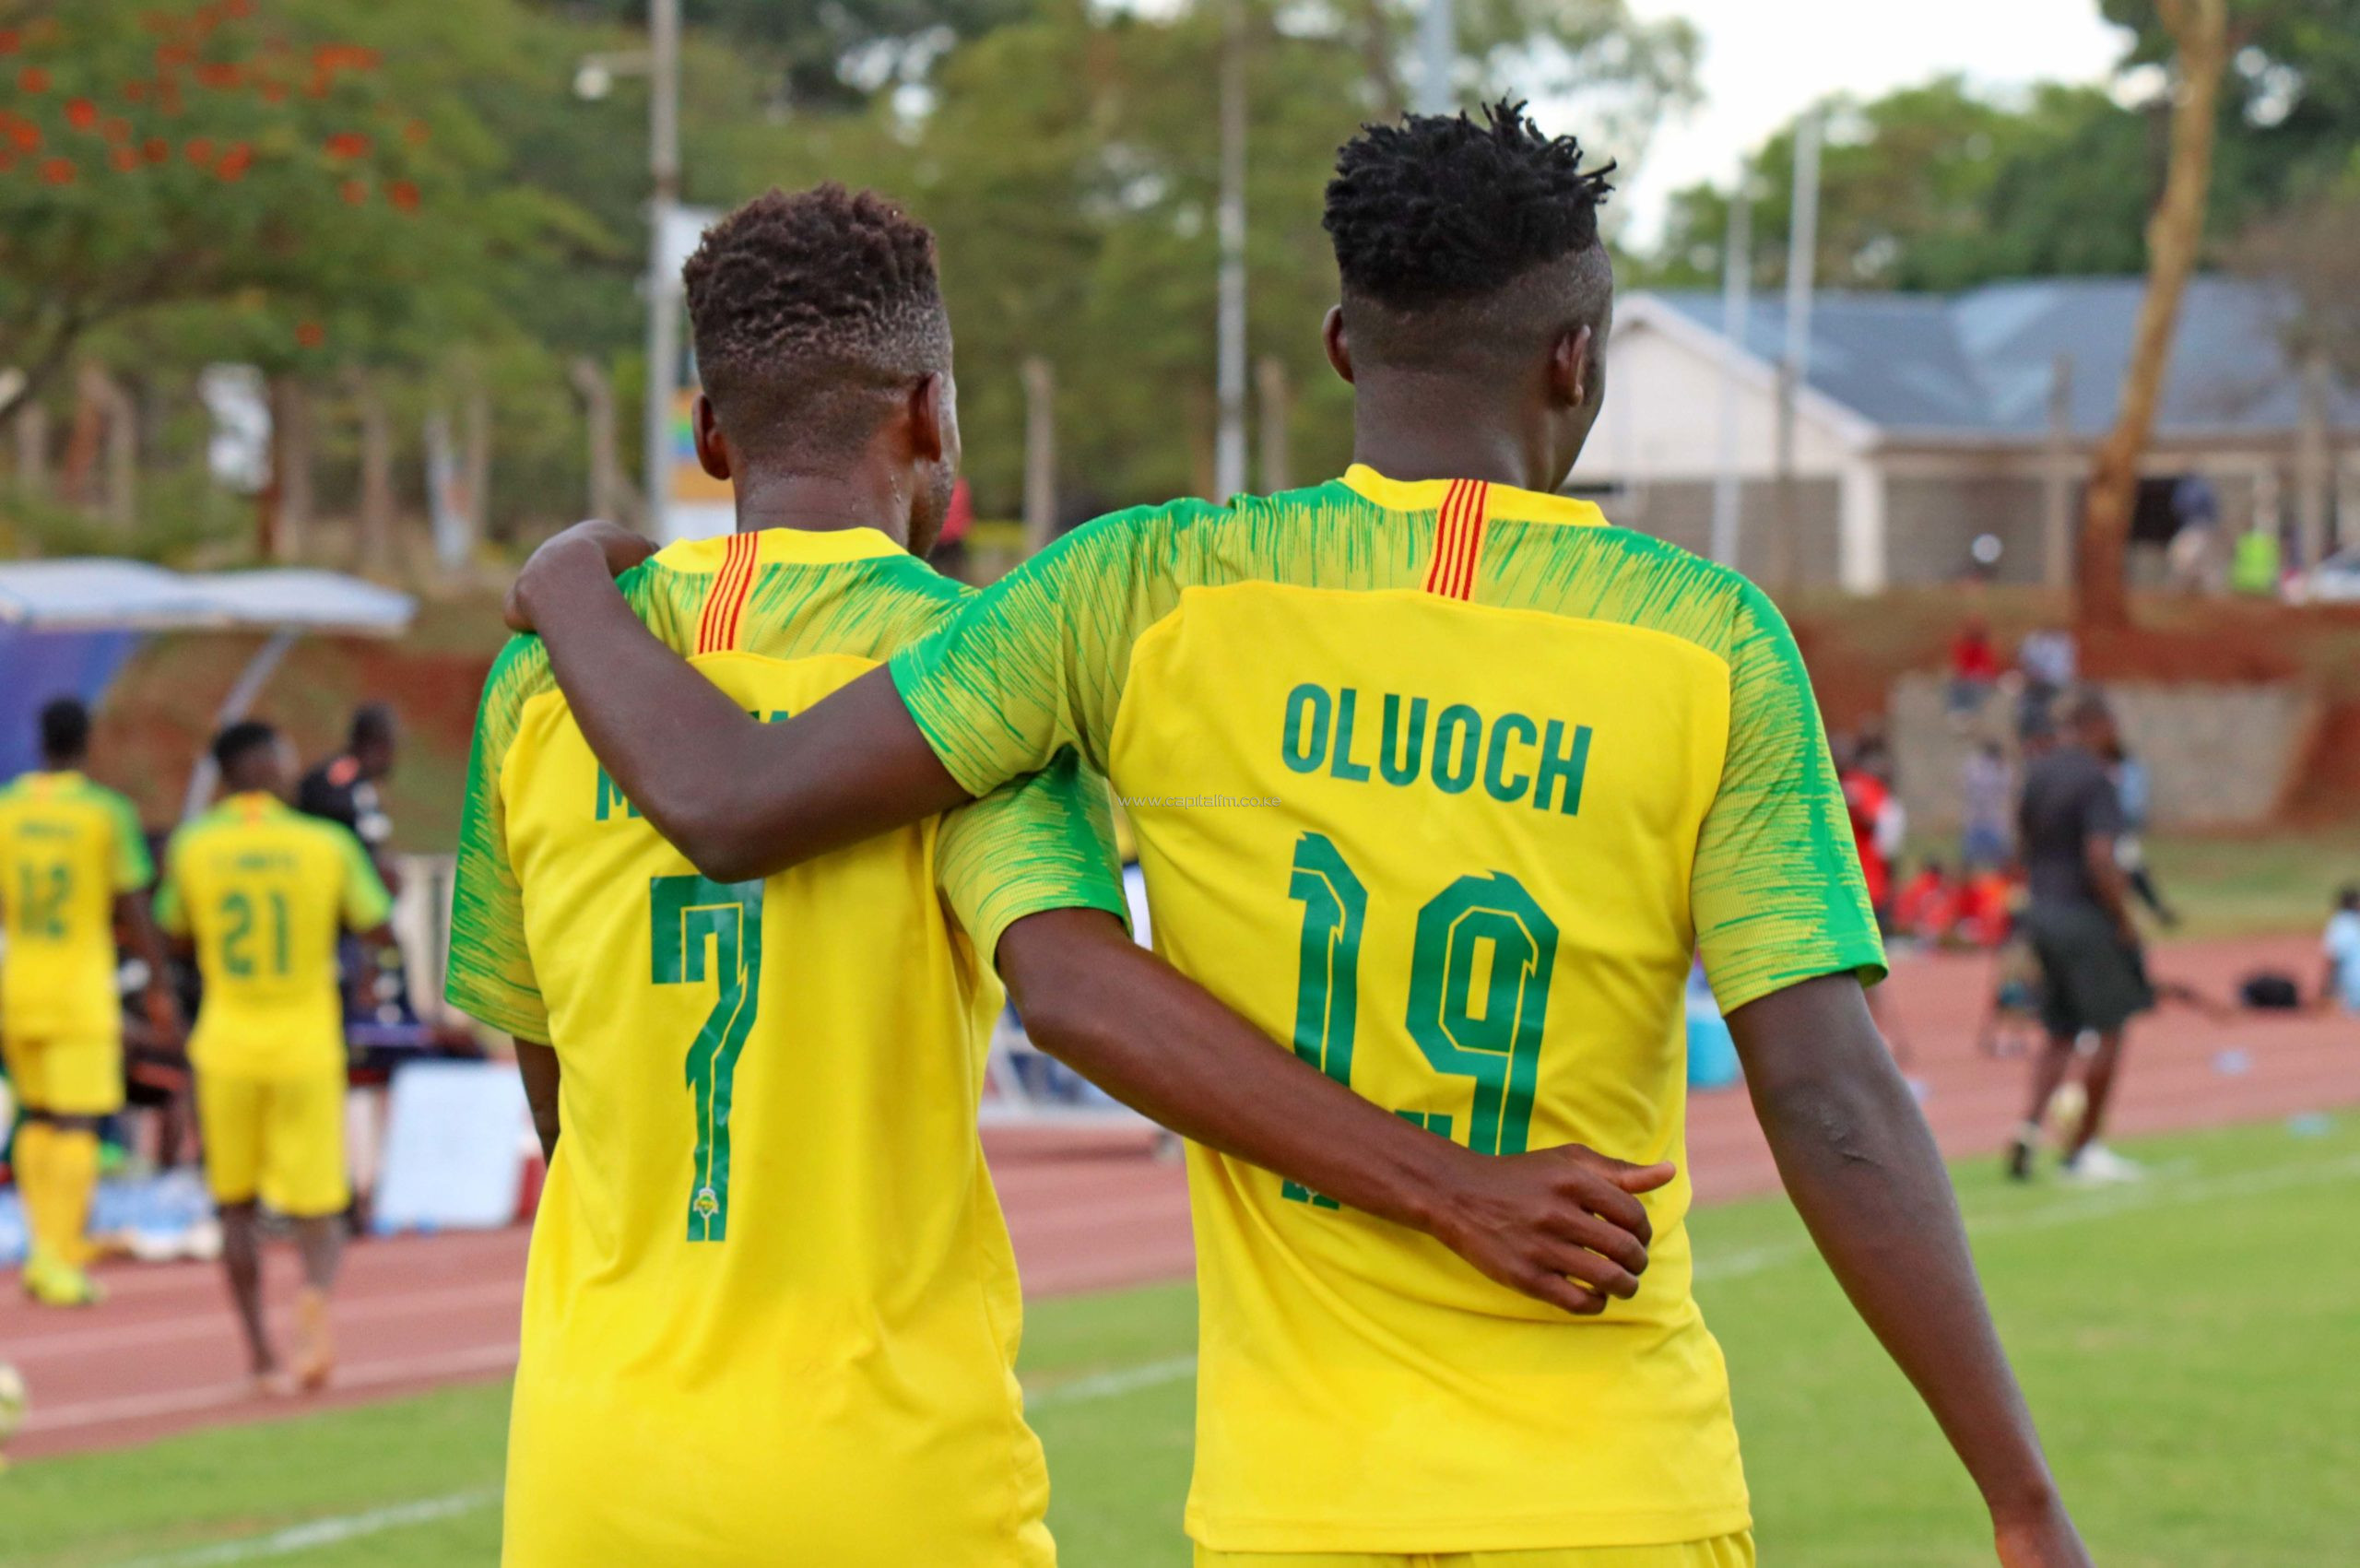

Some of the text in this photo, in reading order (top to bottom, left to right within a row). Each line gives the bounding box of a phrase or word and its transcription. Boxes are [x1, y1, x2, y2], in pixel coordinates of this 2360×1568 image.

[1281, 683, 1593, 816] OLUOCH
[219, 890, 290, 977] 21
[650, 874, 765, 1242] 7
[1281, 831, 1560, 1210] 19
